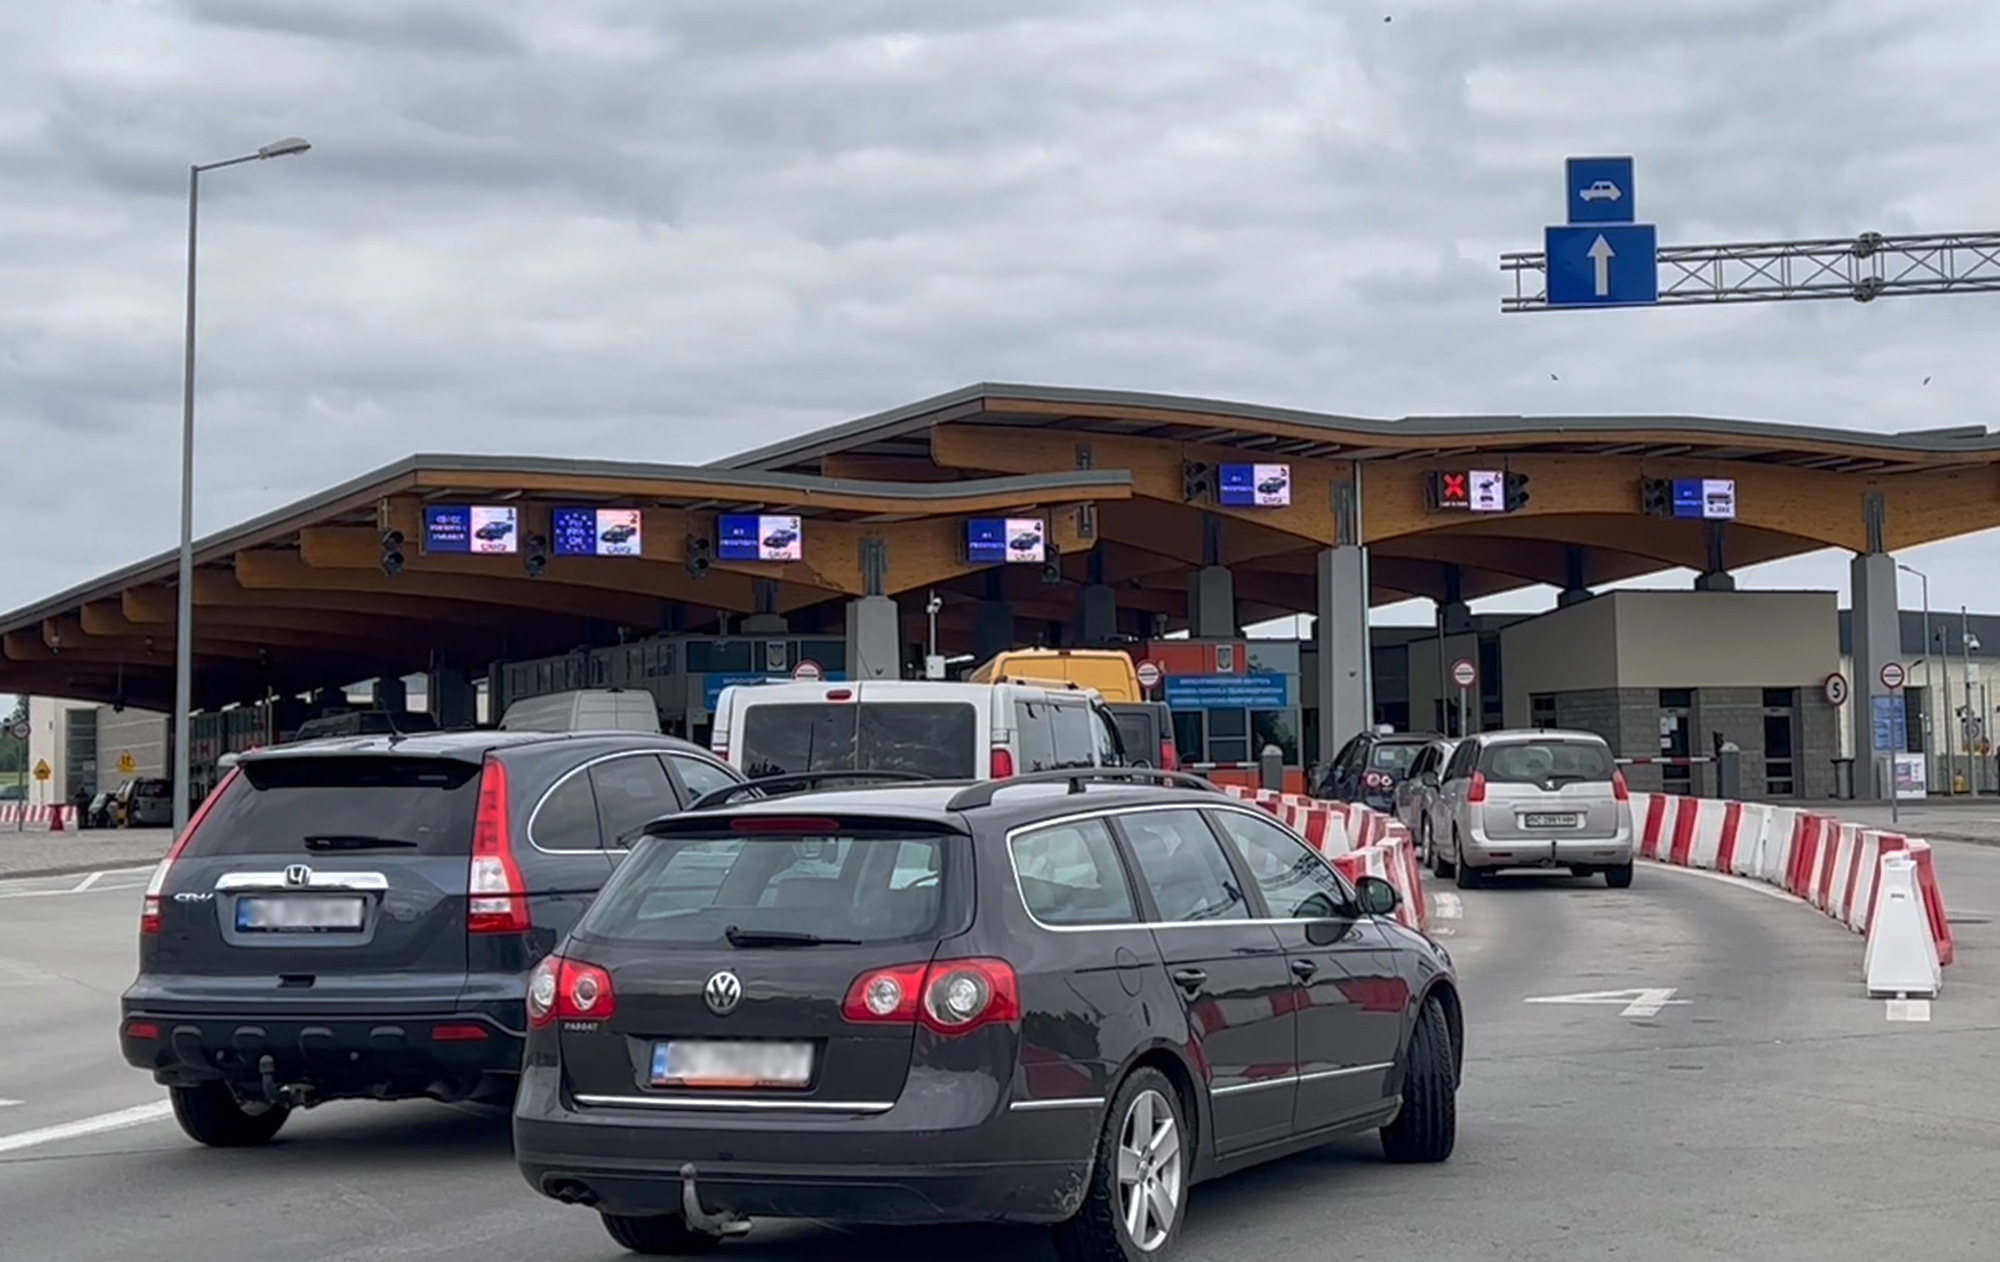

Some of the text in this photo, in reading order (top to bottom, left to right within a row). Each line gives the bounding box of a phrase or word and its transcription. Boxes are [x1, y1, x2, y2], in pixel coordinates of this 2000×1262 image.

[506, 508, 514, 521] 1
[629, 512, 638, 524] 2
[790, 518, 798, 529] 3
[1033, 521, 1041, 532] 4
[563, 1021, 598, 1031] PASSAT
